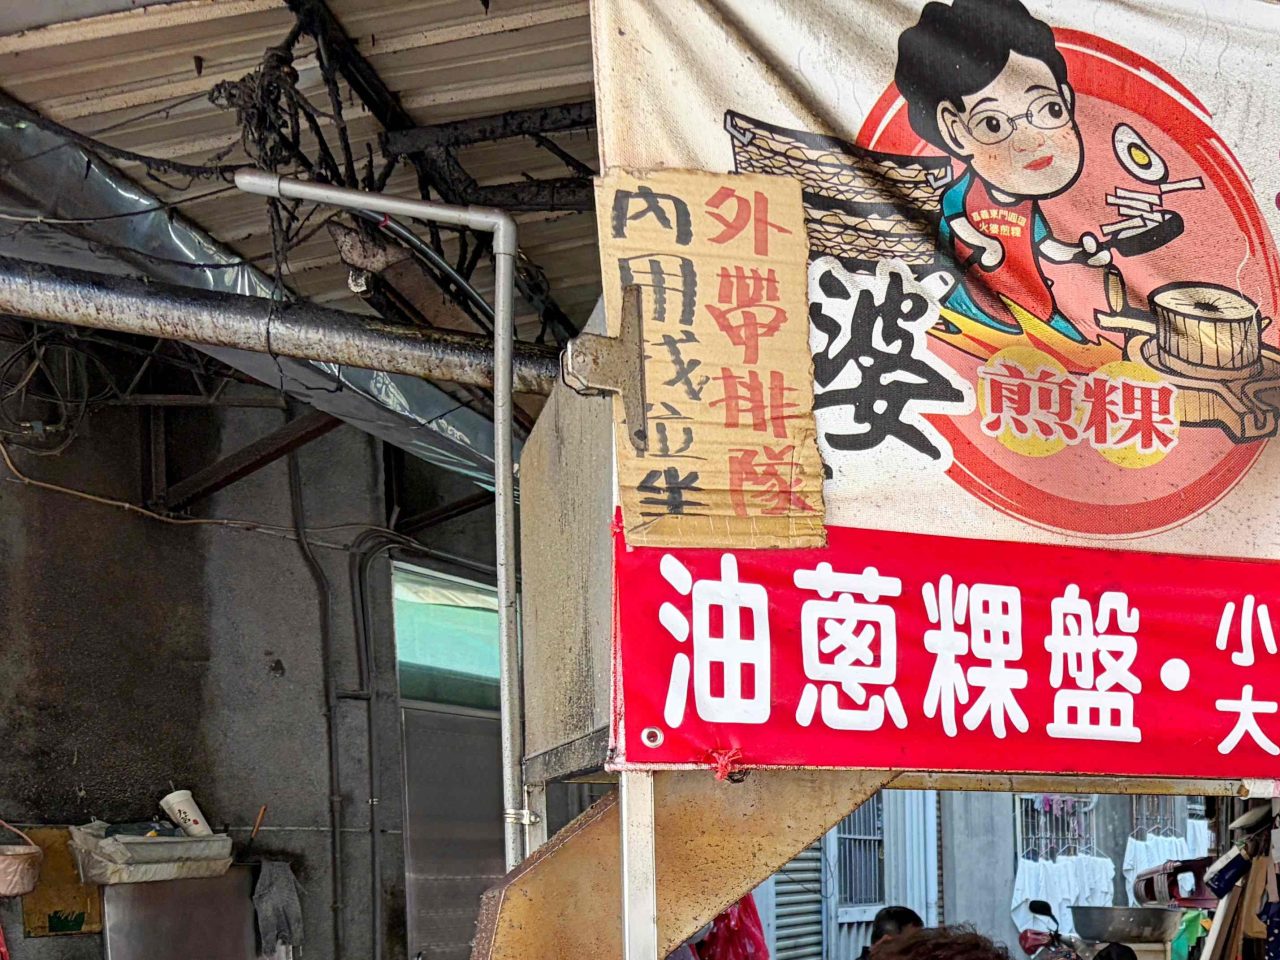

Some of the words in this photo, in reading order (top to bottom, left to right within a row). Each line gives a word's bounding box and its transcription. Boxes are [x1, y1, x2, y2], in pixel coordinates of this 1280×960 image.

[704, 186, 814, 516] 外帶排隊
[813, 268, 966, 470] 婆
[982, 366, 1179, 452] 煎粿
